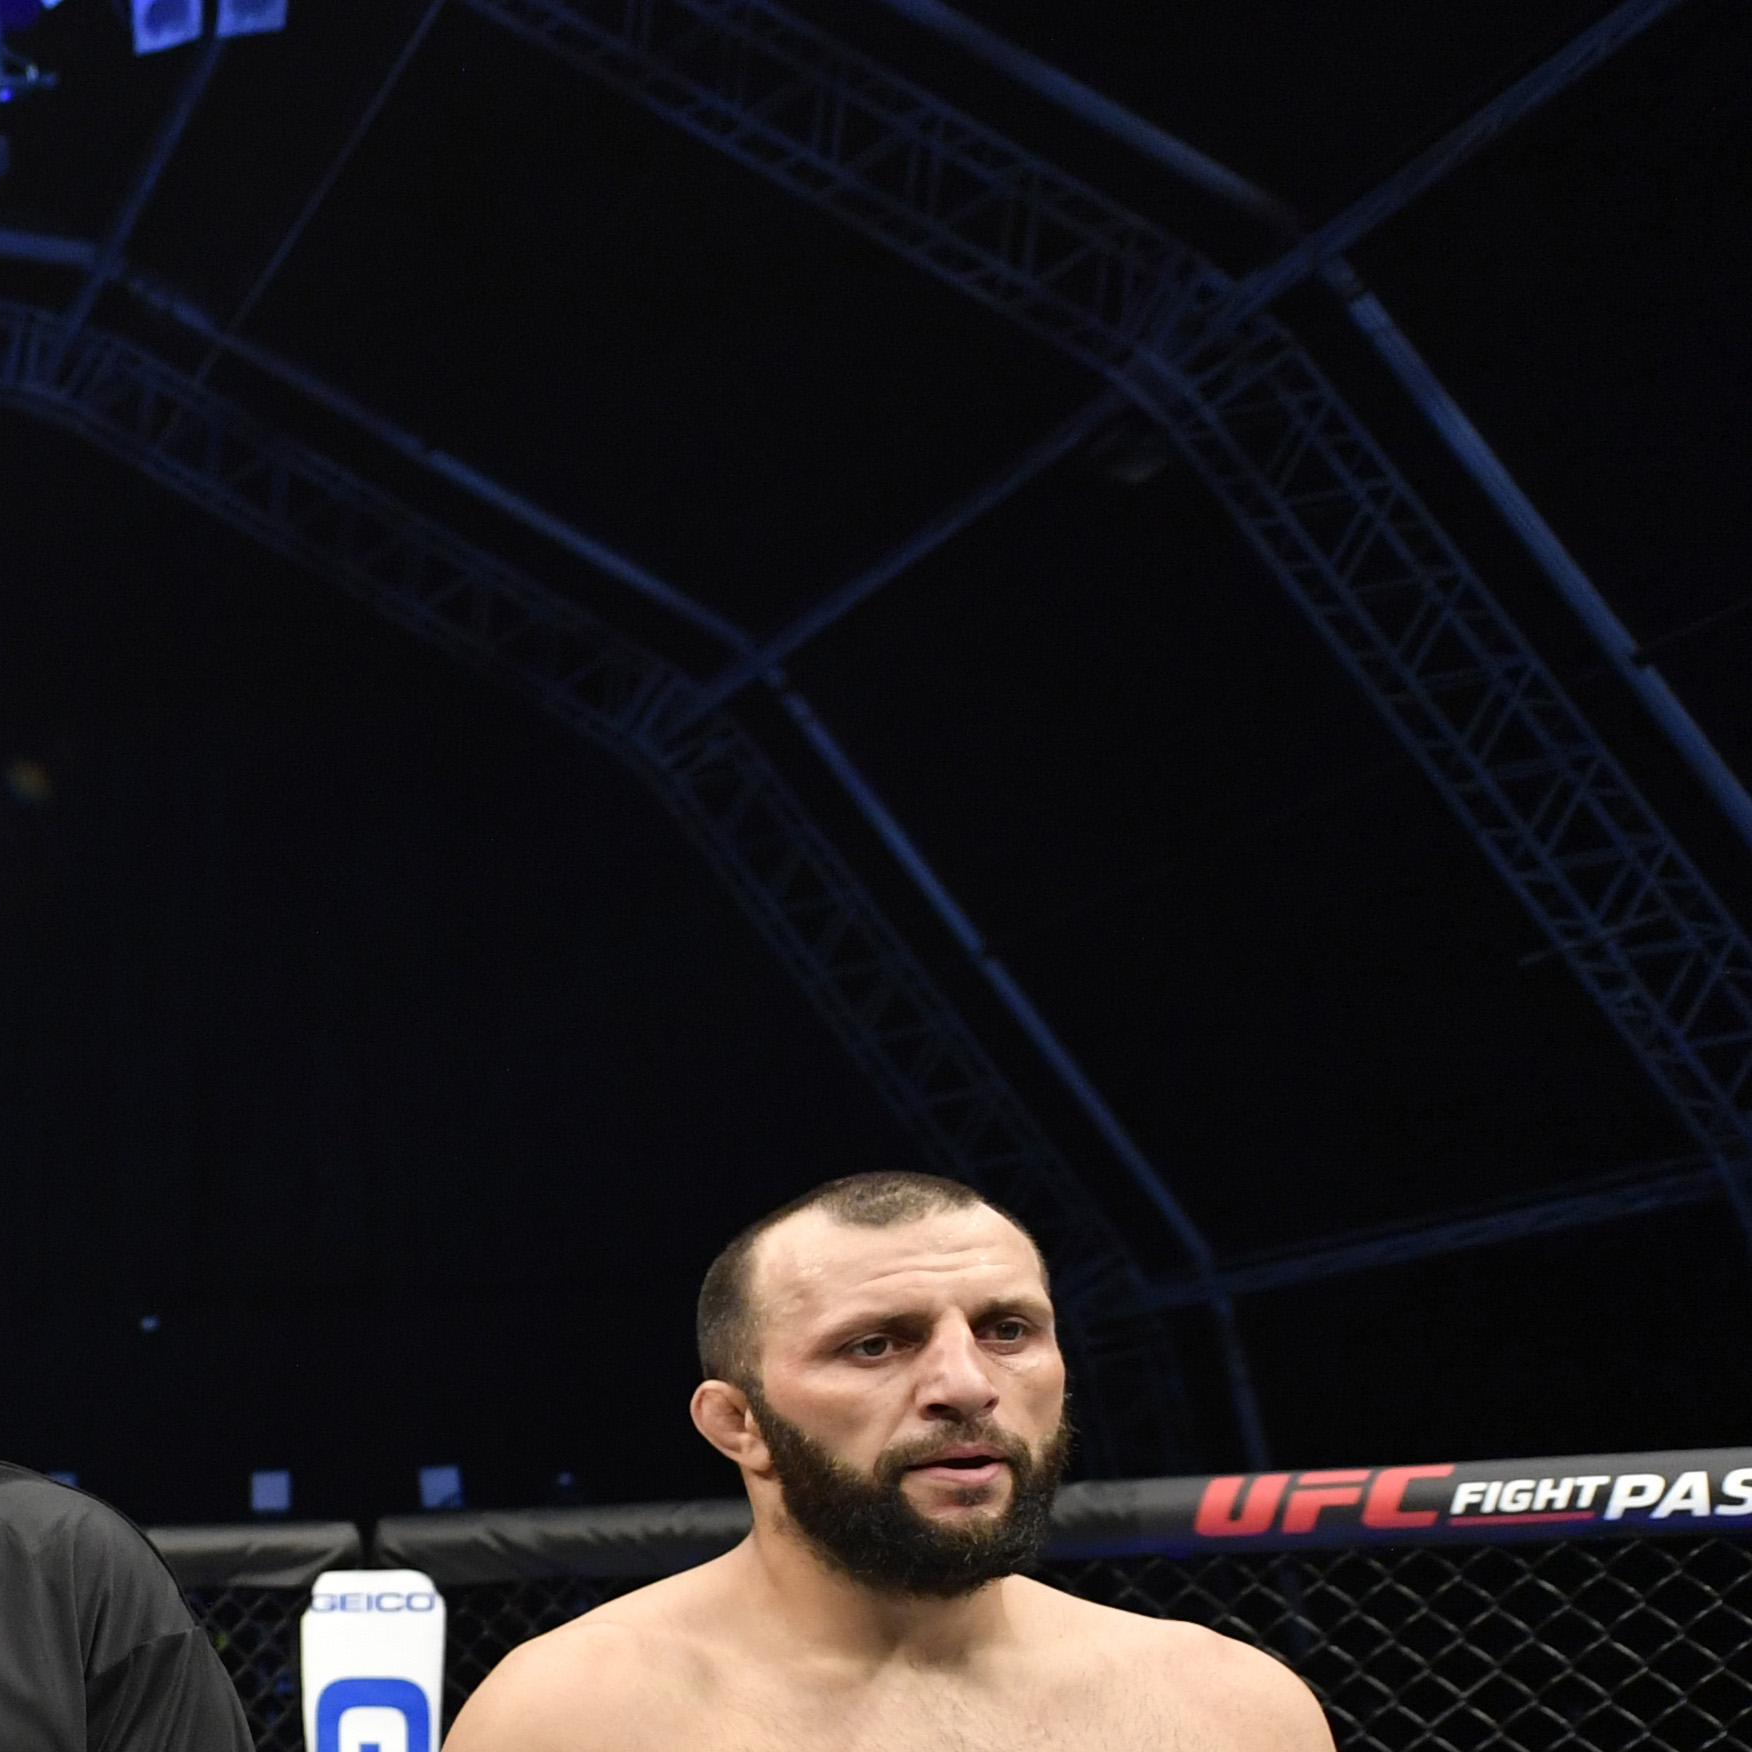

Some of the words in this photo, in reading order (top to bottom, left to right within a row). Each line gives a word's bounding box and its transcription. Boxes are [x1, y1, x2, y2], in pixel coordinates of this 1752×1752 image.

[1193, 1464, 1456, 1537] UFC
[1449, 1475, 1611, 1516] FIGHT
[1603, 1467, 1752, 1521] PAS
[311, 1591, 436, 1614] GEICO
